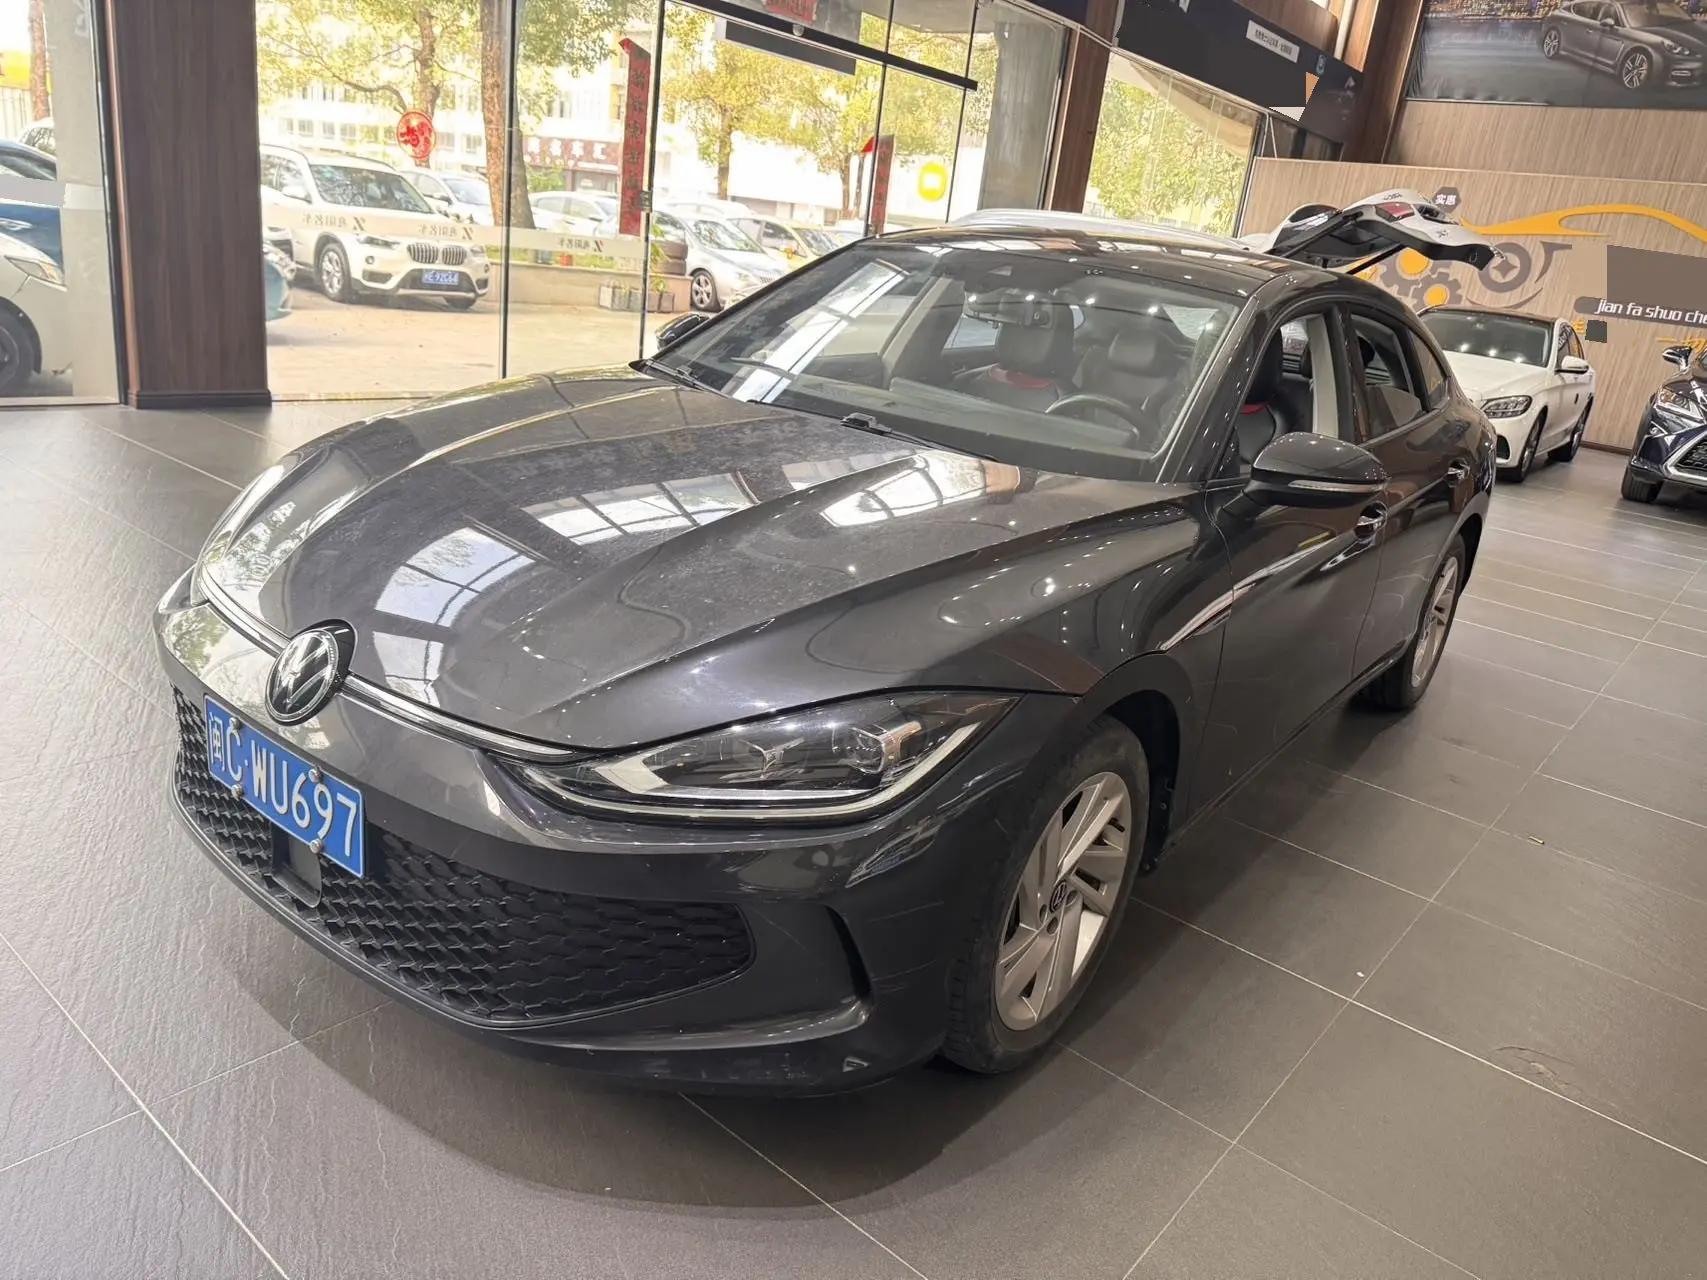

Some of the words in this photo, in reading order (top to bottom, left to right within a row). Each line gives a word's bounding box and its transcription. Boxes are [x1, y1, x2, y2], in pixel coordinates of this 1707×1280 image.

[1435, 194, 1456, 205] 实惠
[1594, 299, 1623, 315] jian
[1625, 302, 1643, 316] fa
[1645, 305, 1682, 321] shuo
